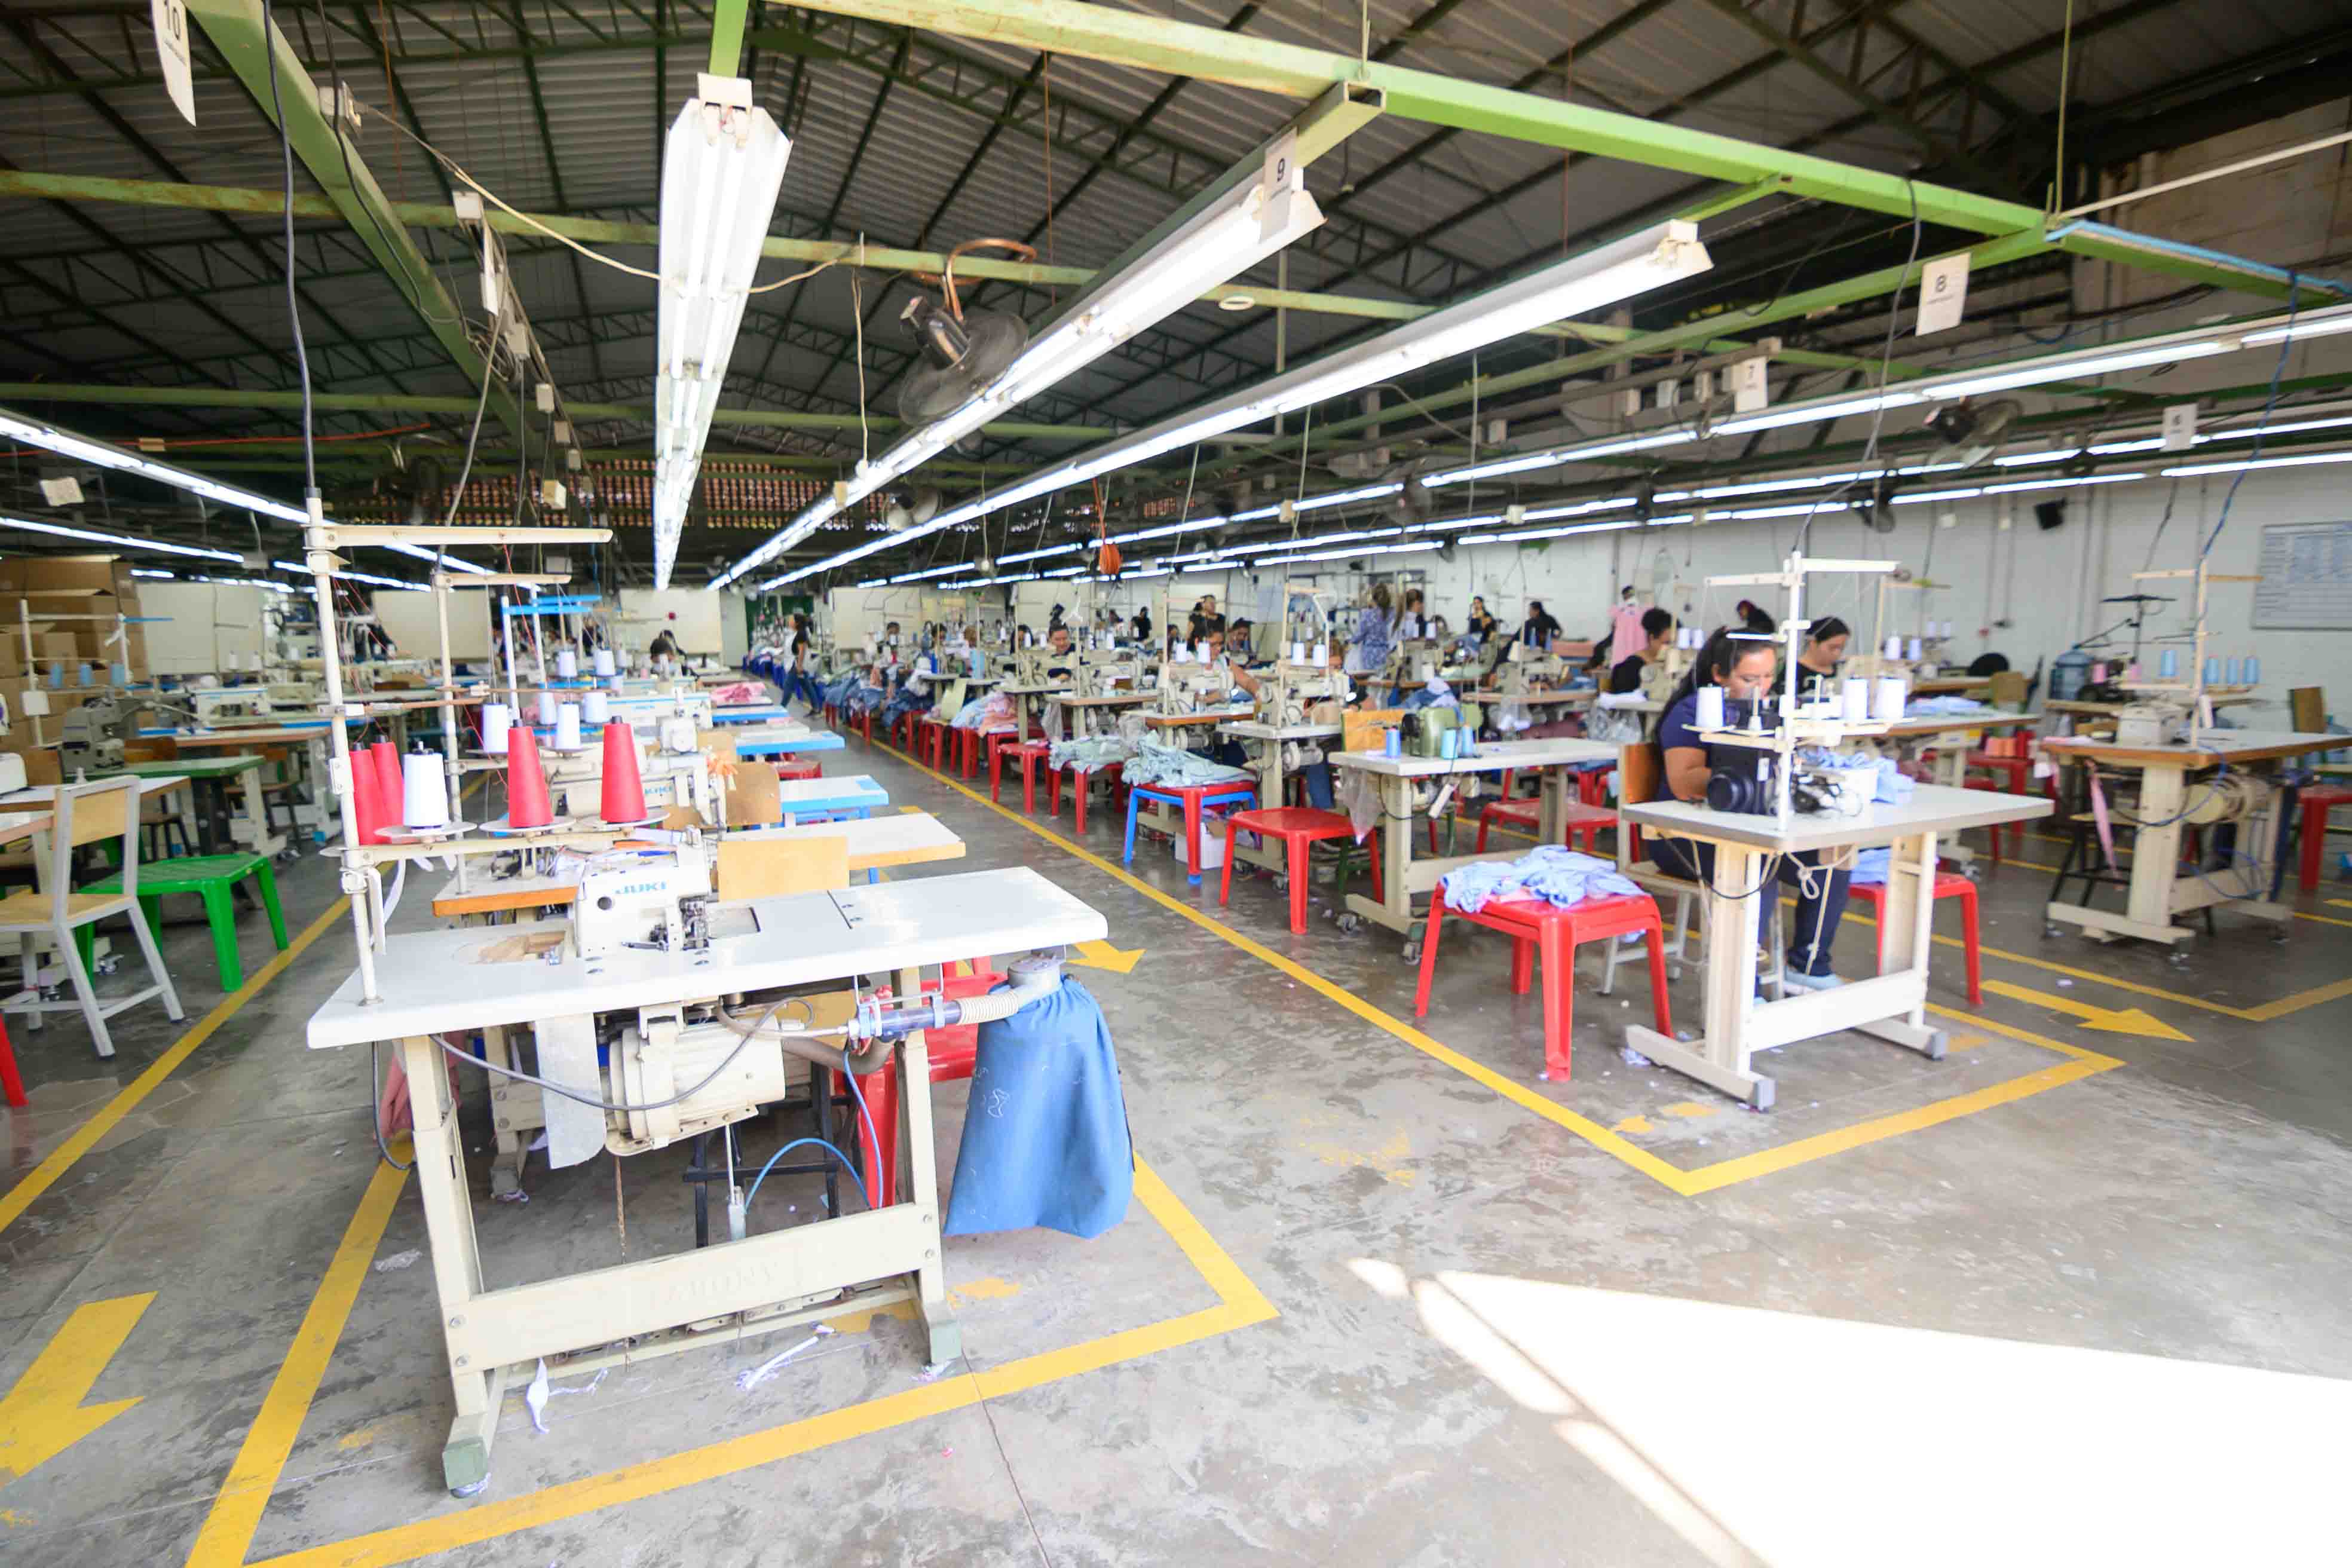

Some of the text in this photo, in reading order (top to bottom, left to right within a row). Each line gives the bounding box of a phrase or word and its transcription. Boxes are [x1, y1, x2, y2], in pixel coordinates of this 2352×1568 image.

[164, 0, 180, 40] 10
[1276, 157, 1285, 182] 9
[1936, 272, 1947, 292] 8
[615, 881, 666, 895] JUKI
